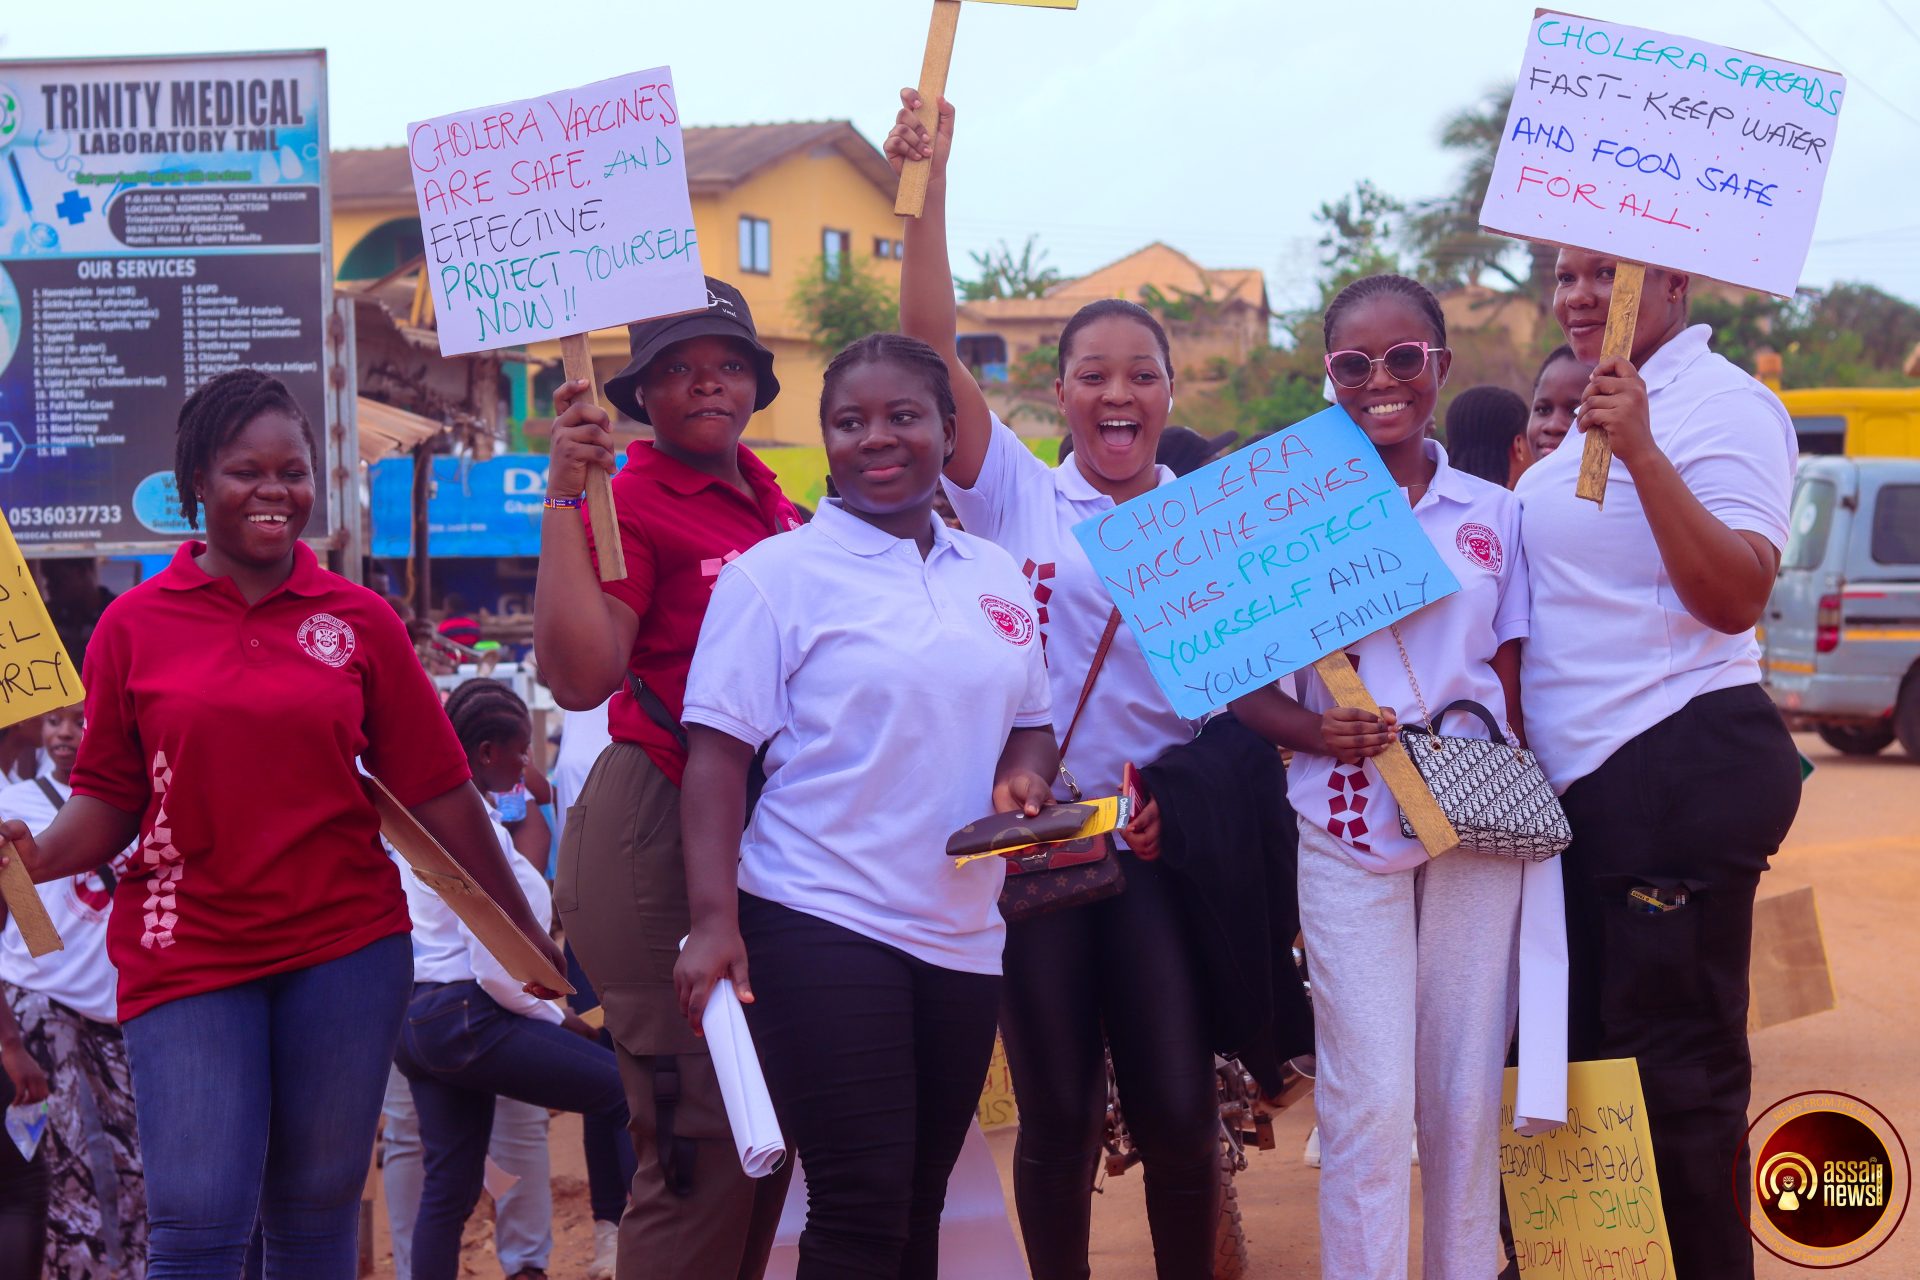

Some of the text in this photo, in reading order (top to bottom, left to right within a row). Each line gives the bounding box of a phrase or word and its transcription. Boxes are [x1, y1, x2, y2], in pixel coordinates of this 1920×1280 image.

[1538, 20, 1842, 116] CHOLERA SPREADS
[41, 79, 304, 131] TRINITY MEDICAL
[411, 83, 677, 173] CHOLERA VACCINES
[1643, 91, 1735, 129] KEEP
[1742, 117, 1827, 164] WATER
[80, 130, 278, 155] LABORATORY TML
[1511, 116, 1779, 207] AND FOOD SAFE
[228, 192, 268, 202] CENTRAL
[271, 191, 307, 201] REGION
[424, 170, 494, 215] ARE
[603, 136, 672, 179] AND
[1516, 165, 1607, 211] FOR
[222, 202, 269, 212] JUNCTION
[77, 258, 197, 279] OUR SERVICES
[441, 250, 561, 312] PROTECT
[229, 305, 250, 316] Fluid
[251, 317, 301, 327] Examination
[251, 328, 301, 338] Examination
[64, 355, 99, 364] Function
[100, 354, 118, 364] Test
[72, 366, 107, 376] Function
[108, 365, 125, 375] Test
[50, 400, 65, 410] Full
[90, 400, 114, 410] Count
[50, 412, 73, 422] Blood
[50, 424, 73, 433] Blood
[9, 505, 122, 526] 0536037733
[1098, 433, 1313, 552] CHOLERA
[1105, 457, 1369, 599] VACCINE SAVES
[1148, 577, 1311, 677] YOURSELF
[1328, 547, 1402, 595] AND
[1184, 572, 1429, 706] YOUR FAMILY
[1558, 1137, 1645, 1184] PREVENT
[1590, 1185, 1656, 1234] SAVES
